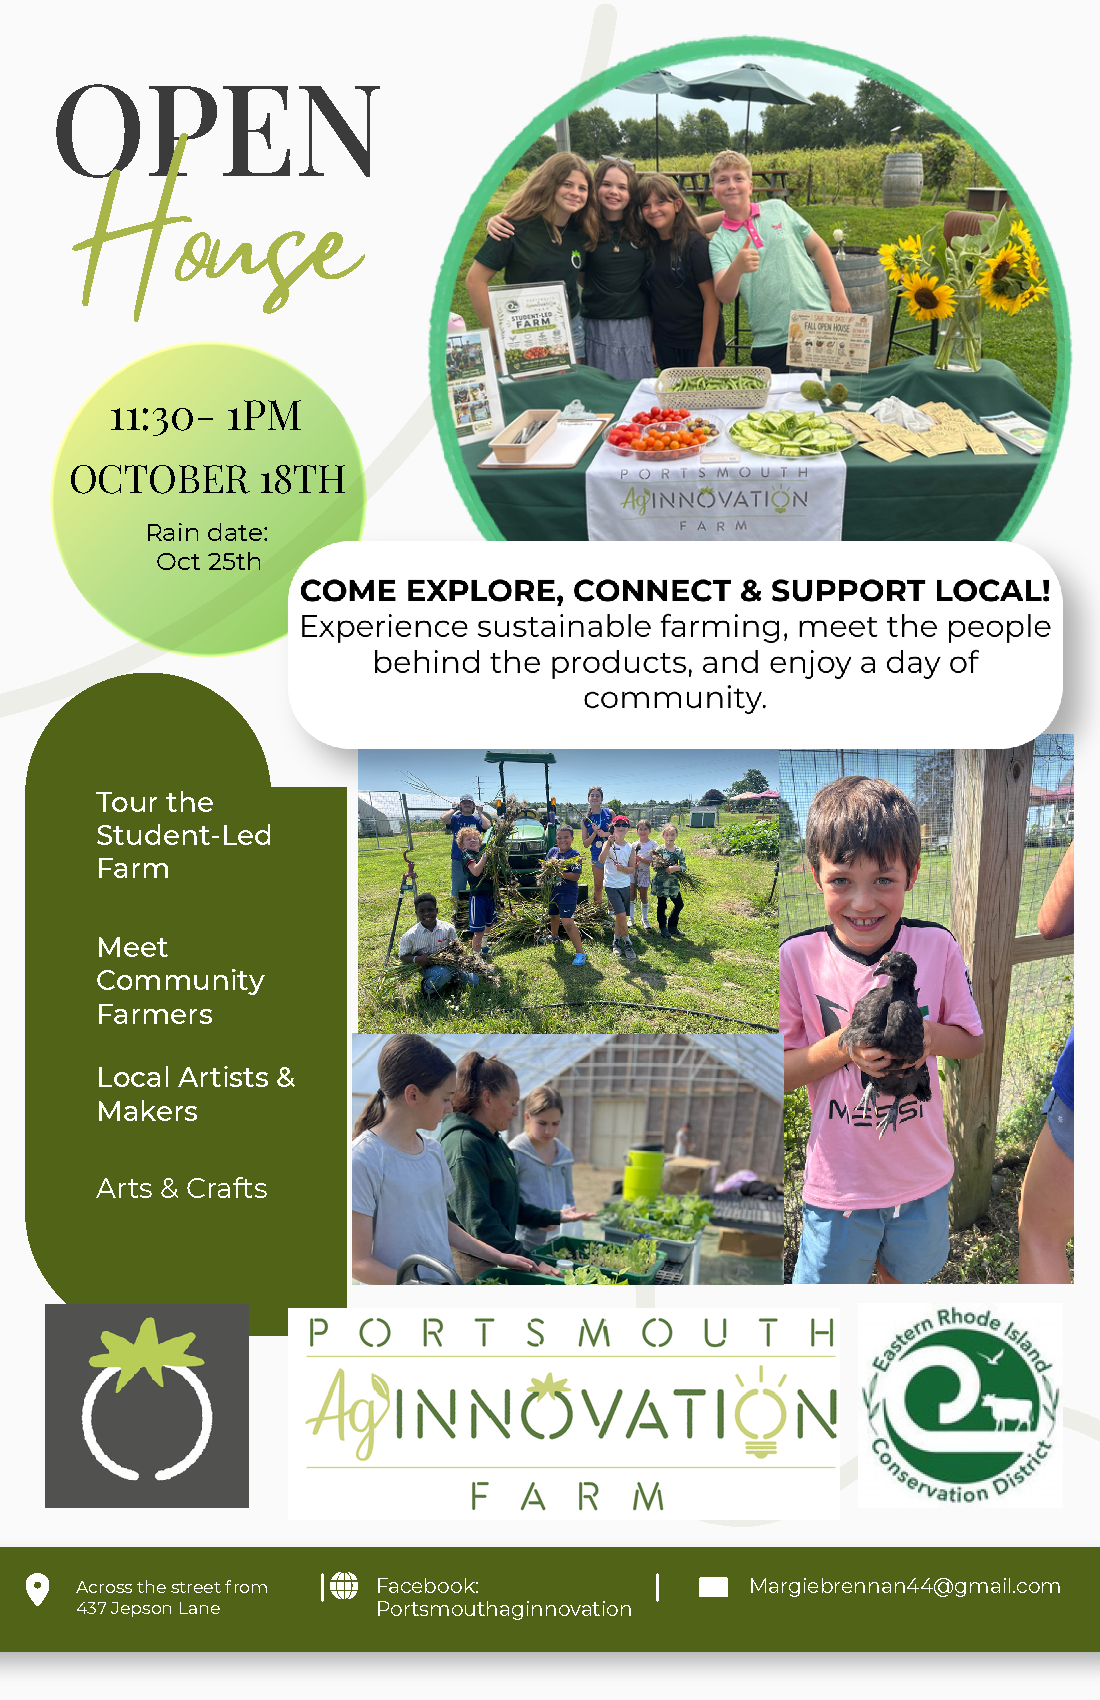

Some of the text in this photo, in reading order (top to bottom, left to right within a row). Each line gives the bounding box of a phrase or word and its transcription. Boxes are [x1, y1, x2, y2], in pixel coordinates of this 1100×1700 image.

[56, 84, 380, 178] OPEN
[72, 132, 366, 323] House
[516, 317, 551, 329] FARM
[804, 321, 816, 331] FALL
[817, 322, 832, 331] OPEN
[833, 323, 851, 333] HOUSE
[110, 400, 302, 437] 11:30- 1PM
[70, 464, 346, 495] OCTOBER 18TH
[620, 467, 808, 480] PORTSMOUTH
[620, 483, 808, 516] AgINNOVATION
[147, 523, 268, 542] Rain date:
[679, 520, 748, 532] FARM
[156, 552, 261, 571] Oct 25th
[300, 578, 1051, 607] COME EXPLORE, CONNECT & SUPPORT LOCAL!
[301, 613, 1052, 644] Experience sustainable farming, meet the people
[373, 649, 980, 680] behind the products, and enjoy a day of
[584, 685, 768, 715] community.
[96, 790, 214, 813] Tour the
[96, 823, 271, 846] Student-Led
[97, 857, 169, 879] Farm
[97, 936, 169, 958] Meet
[96, 968, 266, 996] Community
[97, 1003, 213, 1025] Farmers
[97, 1065, 296, 1088] Local Artists &
[97, 1099, 198, 1122] Makers
[95, 1176, 268, 1199] Arts & Crafts
[308, 1317, 834, 1348] PORTSMOUTH
[872, 1306, 1053, 1374] Eastern Rhode Island
[305, 1365, 838, 1462] AgINNOVATION
[871, 1437, 1052, 1503] Conservation District
[471, 1481, 664, 1511] FARM
[75, 1580, 268, 1594] Across the street from
[376, 1577, 480, 1594] Facebook:
[749, 1577, 1062, 1599] Margiebrennan44@gmail.com
[76, 1601, 221, 1618] 437 Jepson Lane
[376, 1599, 633, 1621] Portsmouthaginnovation
